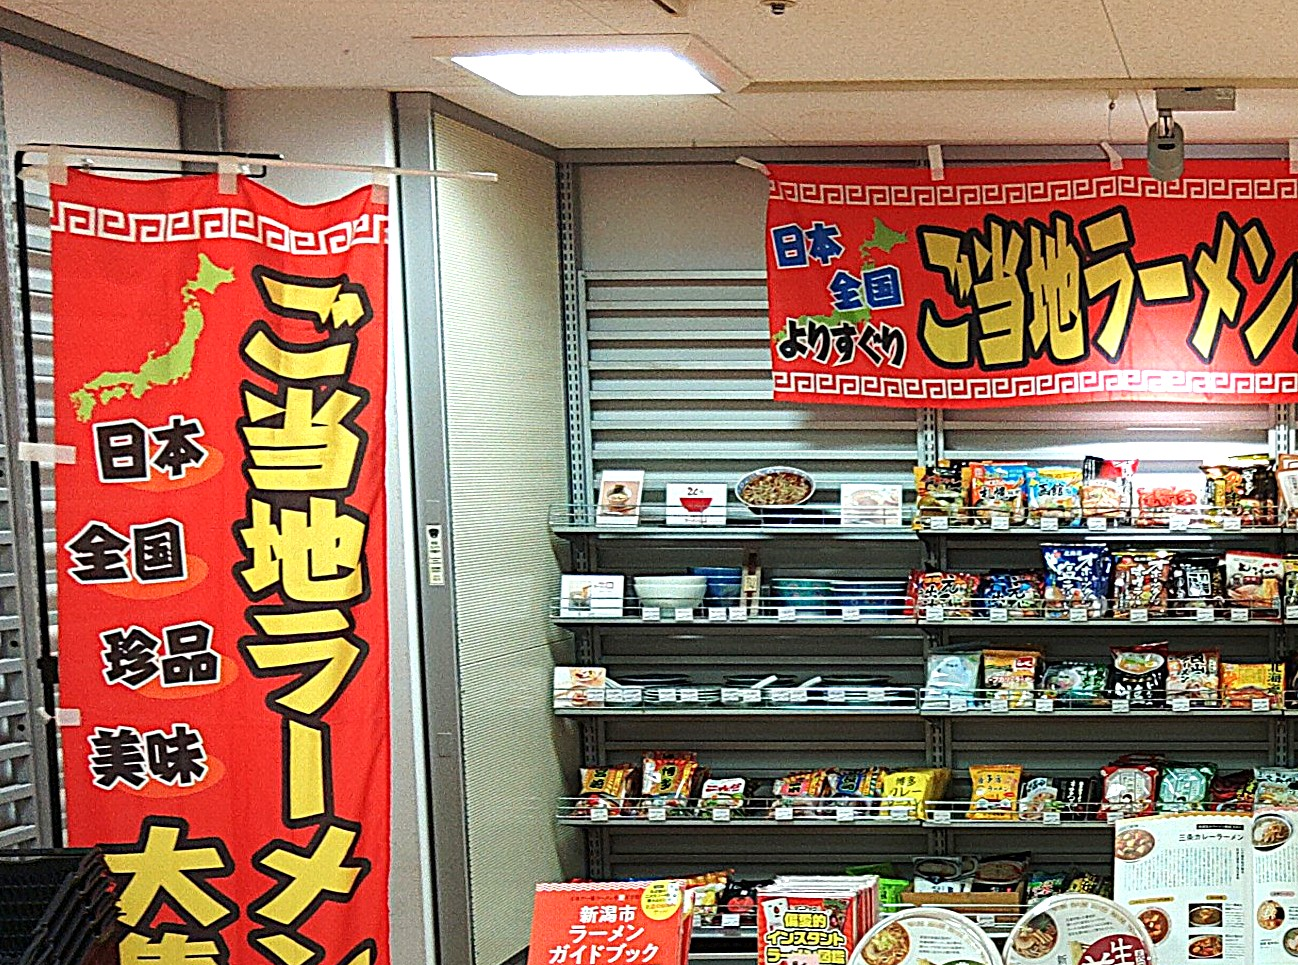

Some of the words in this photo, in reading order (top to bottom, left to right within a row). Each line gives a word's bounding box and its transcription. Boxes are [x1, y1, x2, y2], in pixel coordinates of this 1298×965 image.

[771, 220, 845, 267] 日本
[827, 264, 904, 311] 全国
[776, 319, 907, 369] よりすぐり
[93, 416, 206, 483] 日本
[66, 520, 188, 584] 全国
[101, 622, 221, 688] 珍品
[87, 724, 208, 790] 美味
[569, 925, 645, 943] ラーメン
[580, 905, 637, 923] 新潟市
[549, 943, 660, 965] ガイドブック
[766, 931, 845, 947] インスタント
